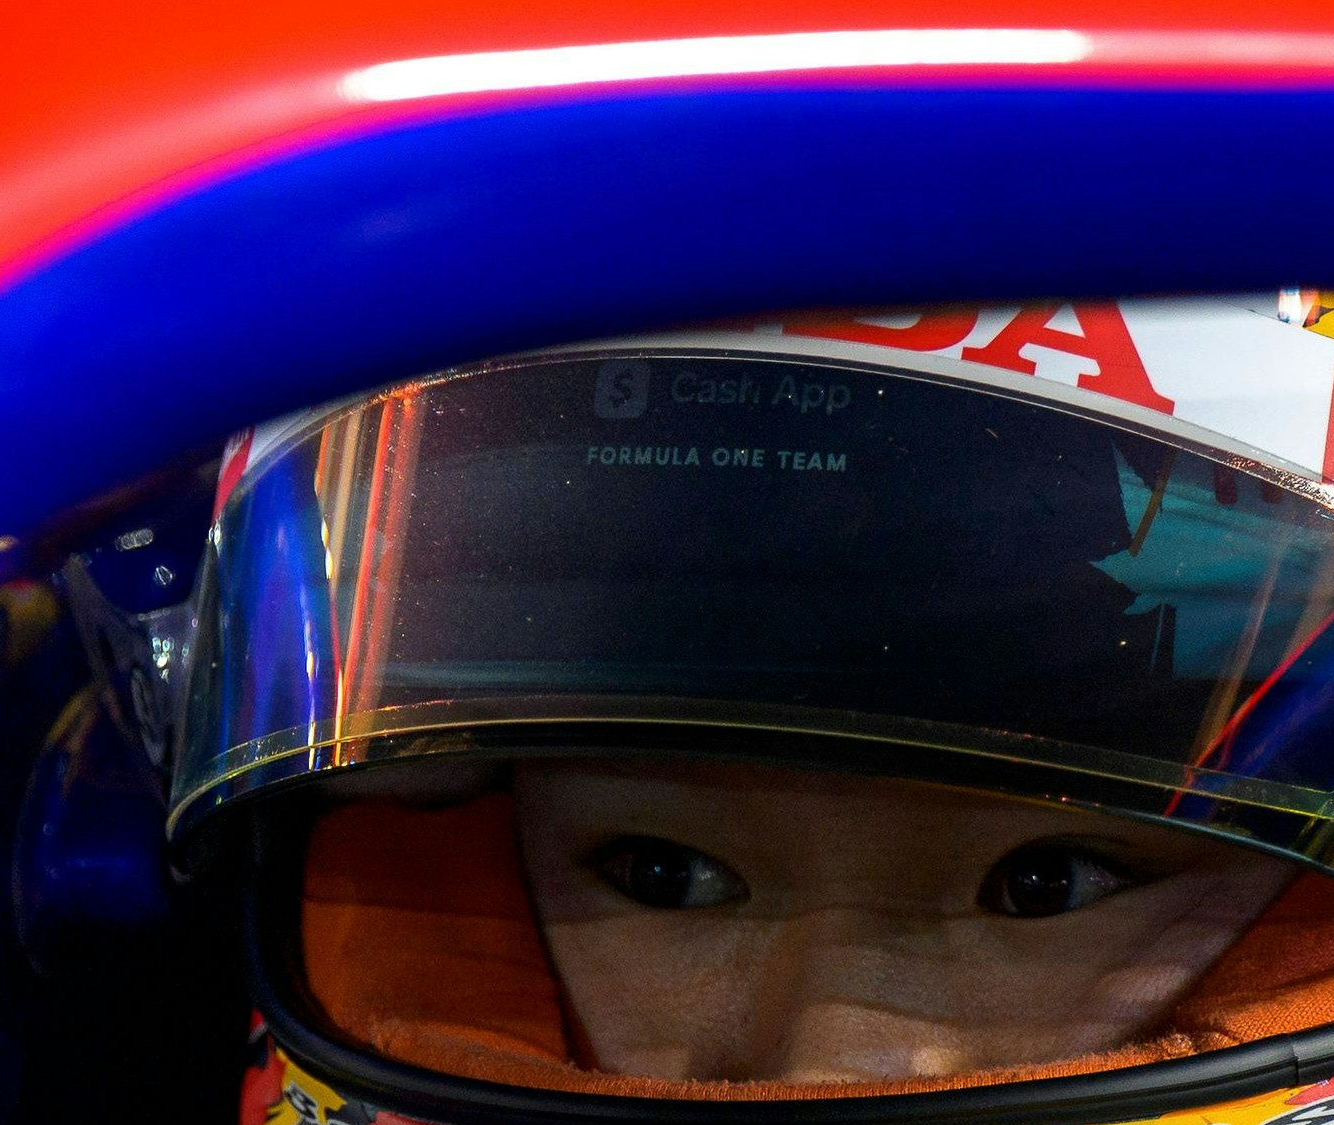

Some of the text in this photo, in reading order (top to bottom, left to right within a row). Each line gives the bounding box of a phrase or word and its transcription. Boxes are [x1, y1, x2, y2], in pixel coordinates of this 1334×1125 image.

[671, 371, 852, 415] Cash App
[587, 447, 848, 472] FORMULA ONE TEAM
